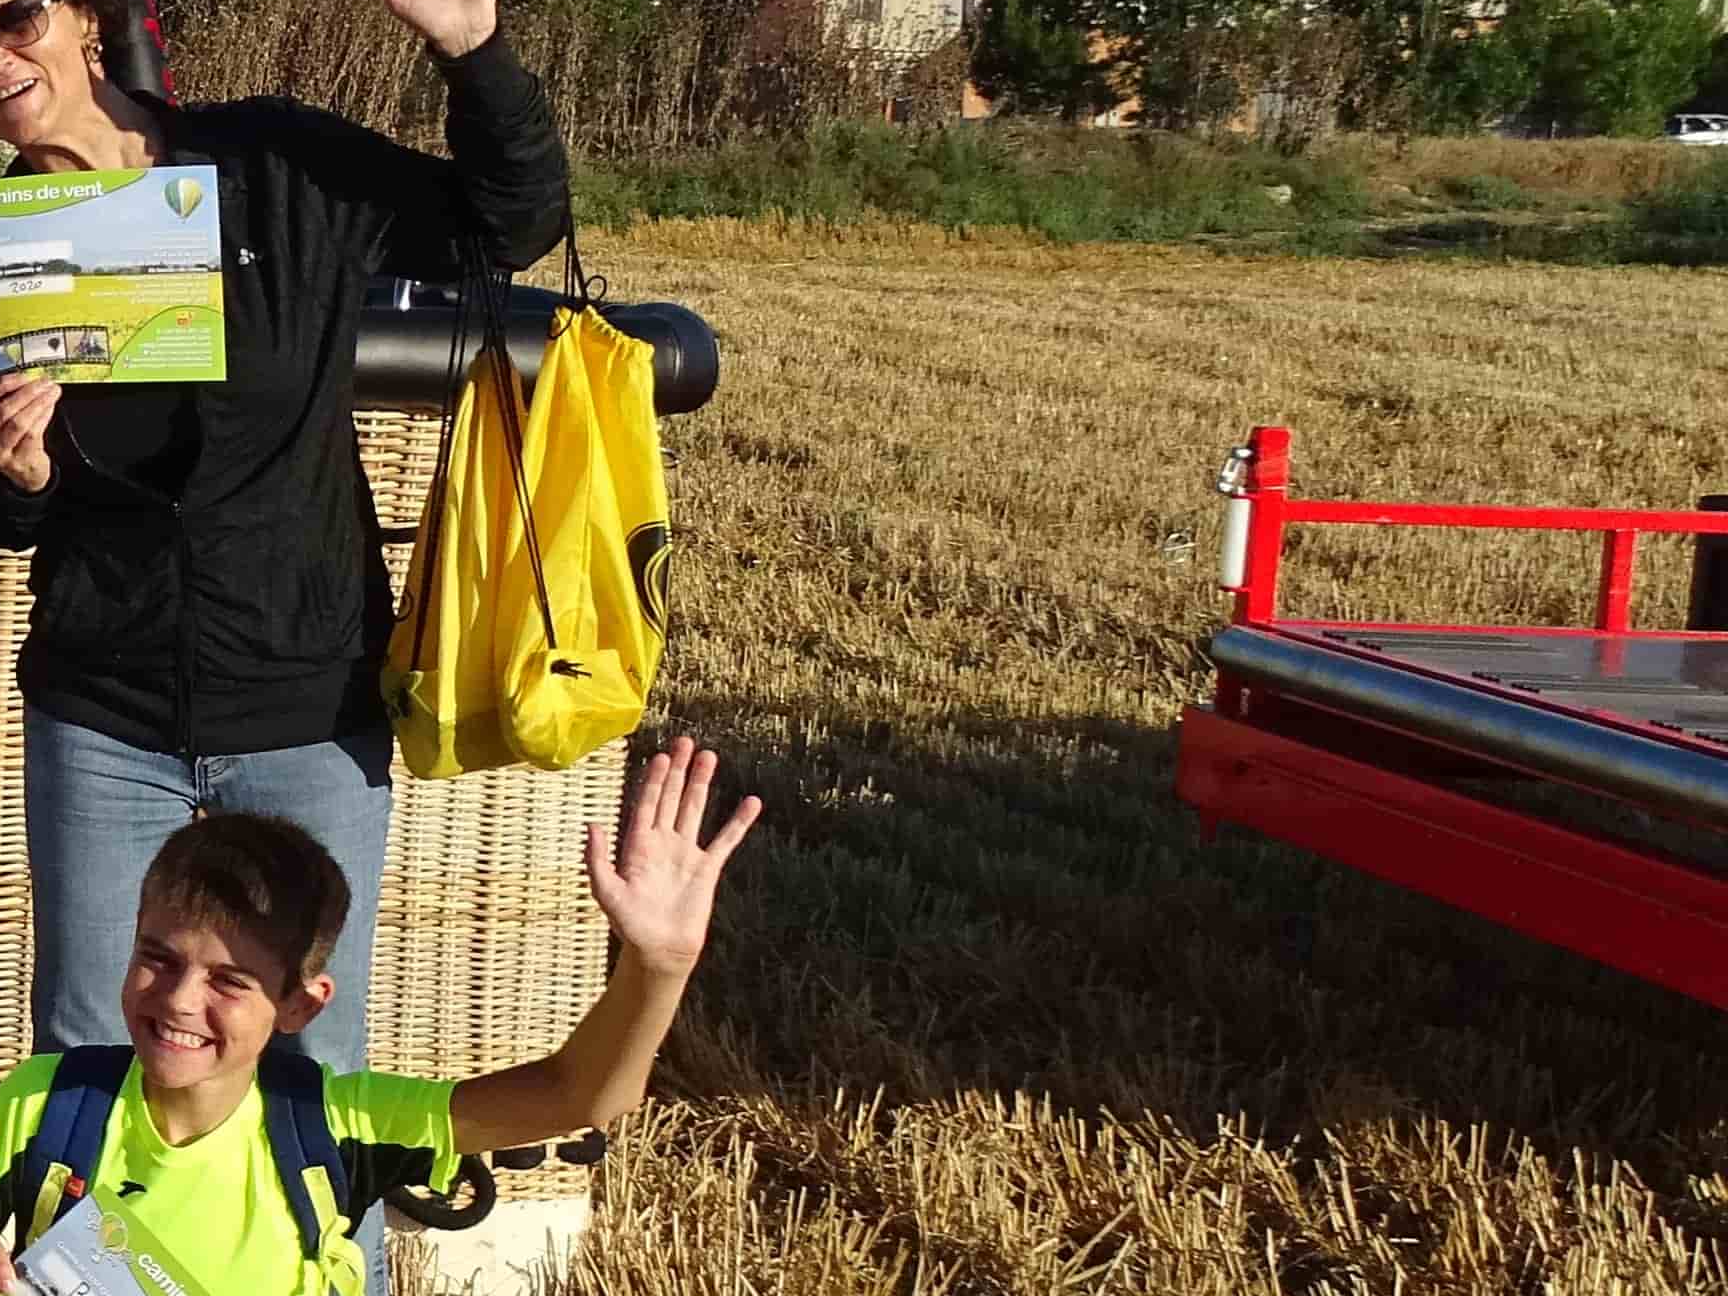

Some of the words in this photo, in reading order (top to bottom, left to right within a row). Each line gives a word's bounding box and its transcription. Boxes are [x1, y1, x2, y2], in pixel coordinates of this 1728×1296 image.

[35, 184, 60, 201] de
[62, 180, 105, 199] vent
[11, 278, 44, 293] 2020
